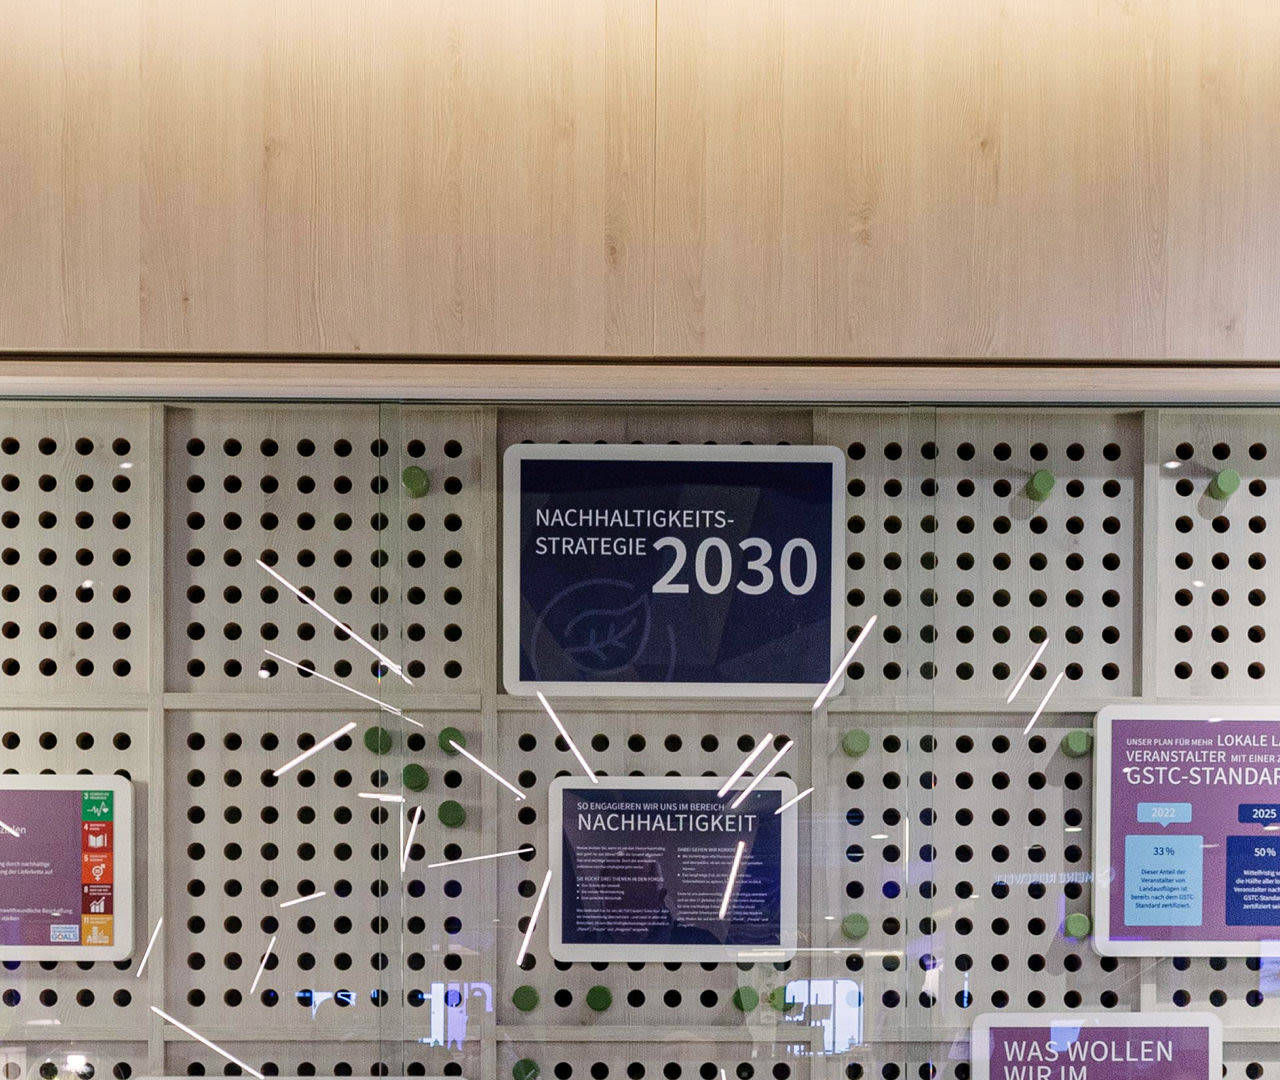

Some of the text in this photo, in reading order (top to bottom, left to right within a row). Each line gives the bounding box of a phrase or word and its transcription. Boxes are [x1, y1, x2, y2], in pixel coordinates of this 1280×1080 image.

[536, 509, 734, 528] NACHHALTIGKEITS-
[535, 536, 818, 595] STRATEGIE 2030
[1126, 738, 1152, 746] UNSER
[1153, 738, 1174, 746] PLAN
[1175, 738, 1190, 746] FÜR
[1191, 738, 1213, 746] MEHR
[1217, 734, 1268, 747] LOKALE
[1126, 750, 1226, 763] VERANSTALTER
[1231, 754, 1247, 764] MIT
[1249, 754, 1275, 764] EINER
[577, 802, 725, 811] SO ENGAGIEREN WIR UNS IM BEREICH
[1151, 807, 1176, 818] 2022
[1252, 809, 1277, 818] 2025
[578, 813, 757, 832] NACHHALTIGKEIT
[1004, 1040, 1173, 1062] WAS WOLLEN
